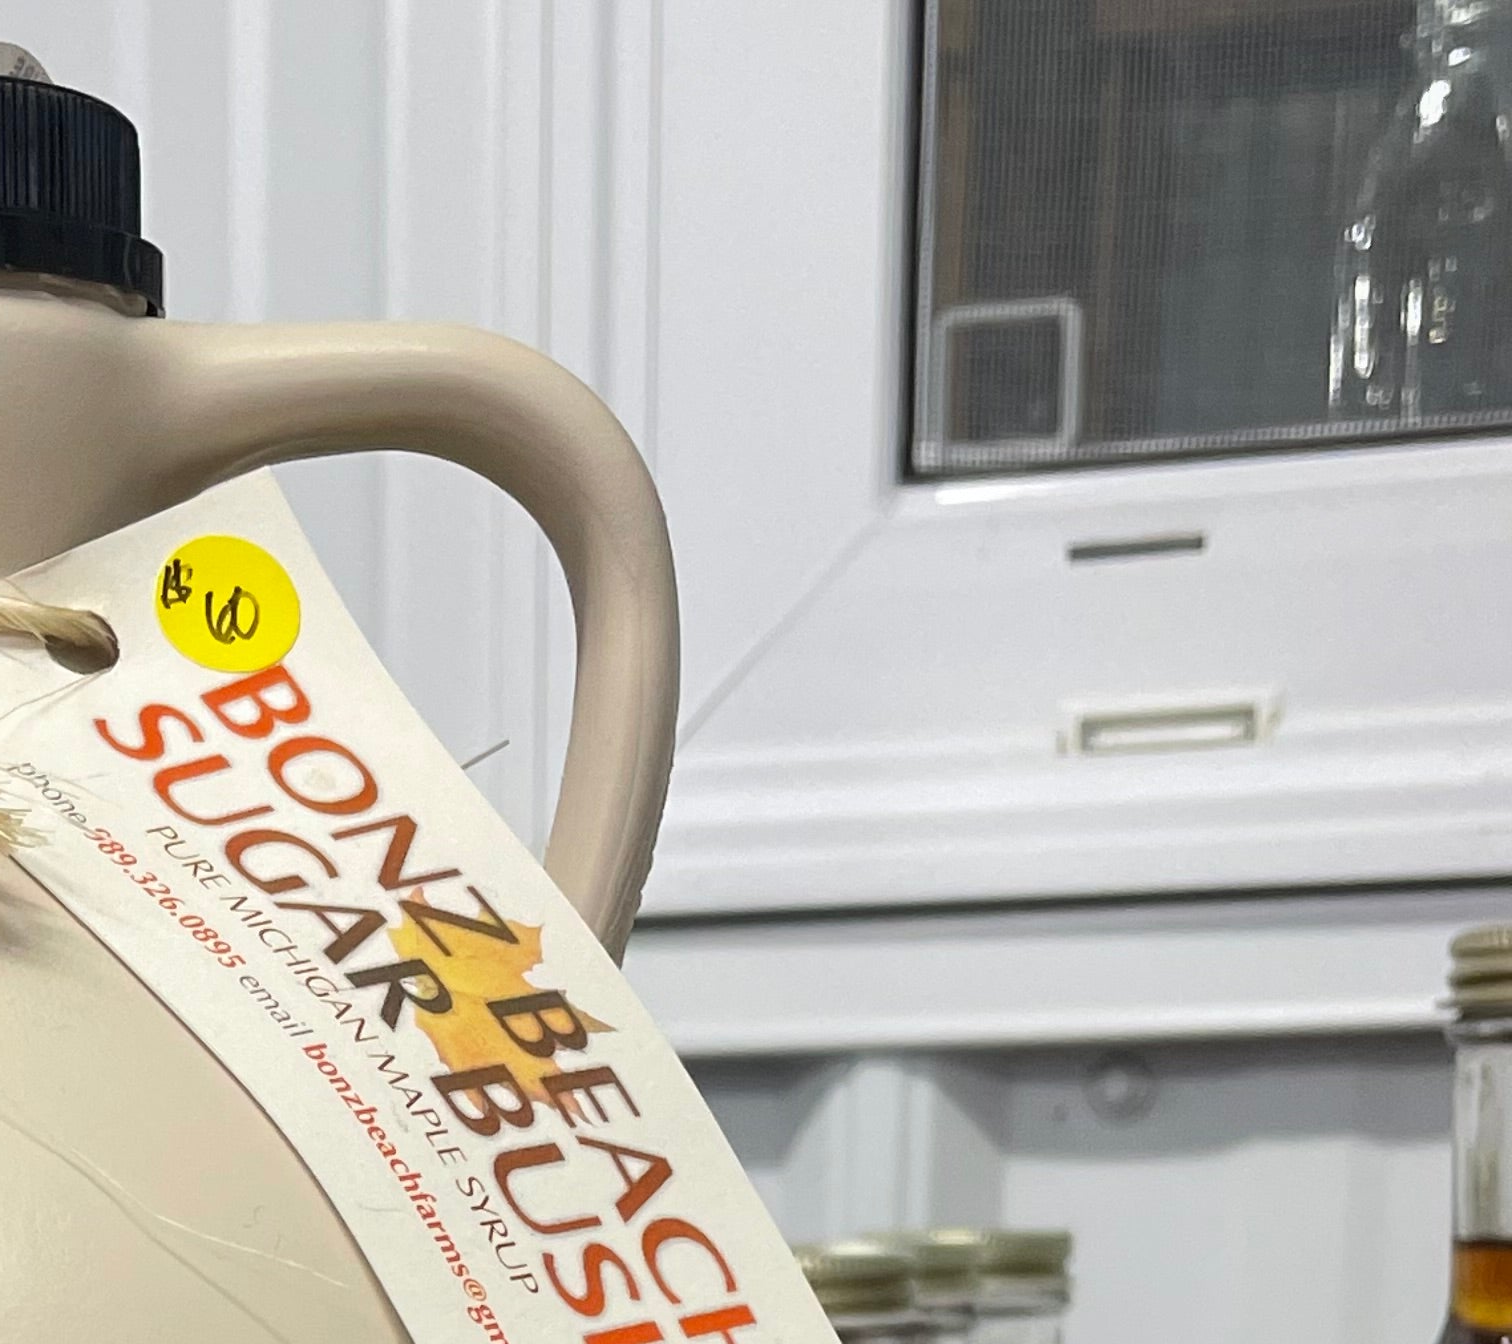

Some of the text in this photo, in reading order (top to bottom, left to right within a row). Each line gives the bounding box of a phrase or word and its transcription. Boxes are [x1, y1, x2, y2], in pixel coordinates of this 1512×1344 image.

[8, 762, 87, 824] phone
[239, 974, 314, 1038] email
[94, 702, 456, 1032] SUGAR
[201, 663, 518, 957] BONZ
[147, 825, 538, 1295] PURE MICHIGAN MAPLE SYRUP
